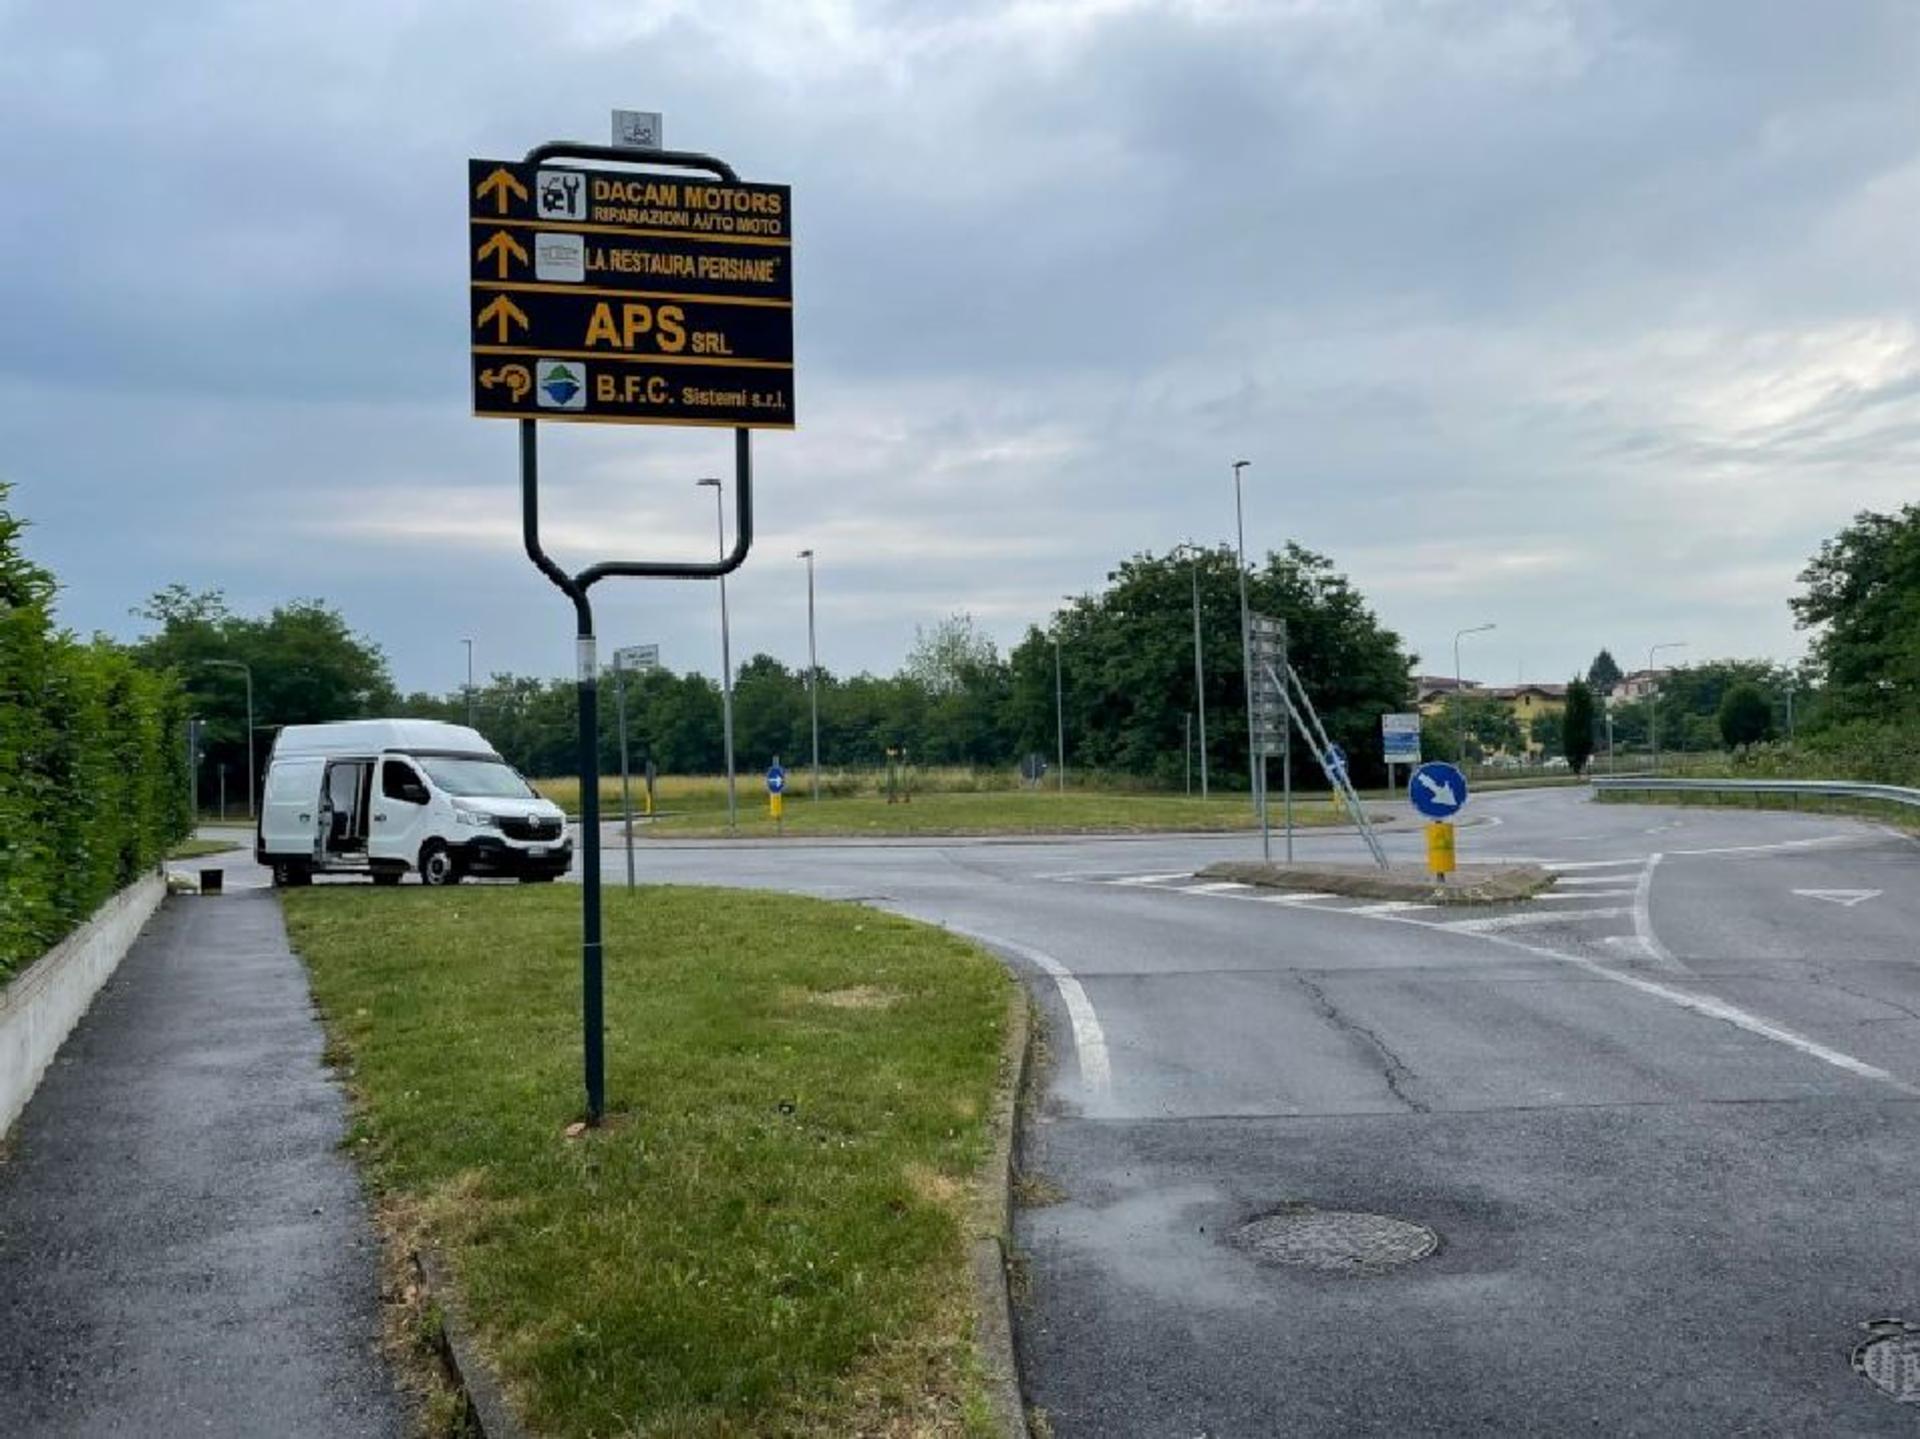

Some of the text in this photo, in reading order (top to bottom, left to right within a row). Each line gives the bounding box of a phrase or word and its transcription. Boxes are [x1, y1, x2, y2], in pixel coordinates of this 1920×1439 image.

[595, 181, 782, 214] DACAM MOTORS
[594, 206, 781, 235] RIPARAZIONI AUTO MOTO
[610, 250, 695, 275] RESTAURA
[585, 302, 733, 354] APS SRL
[597, 374, 786, 409] B.F.C. Sistemi s.r.l.
